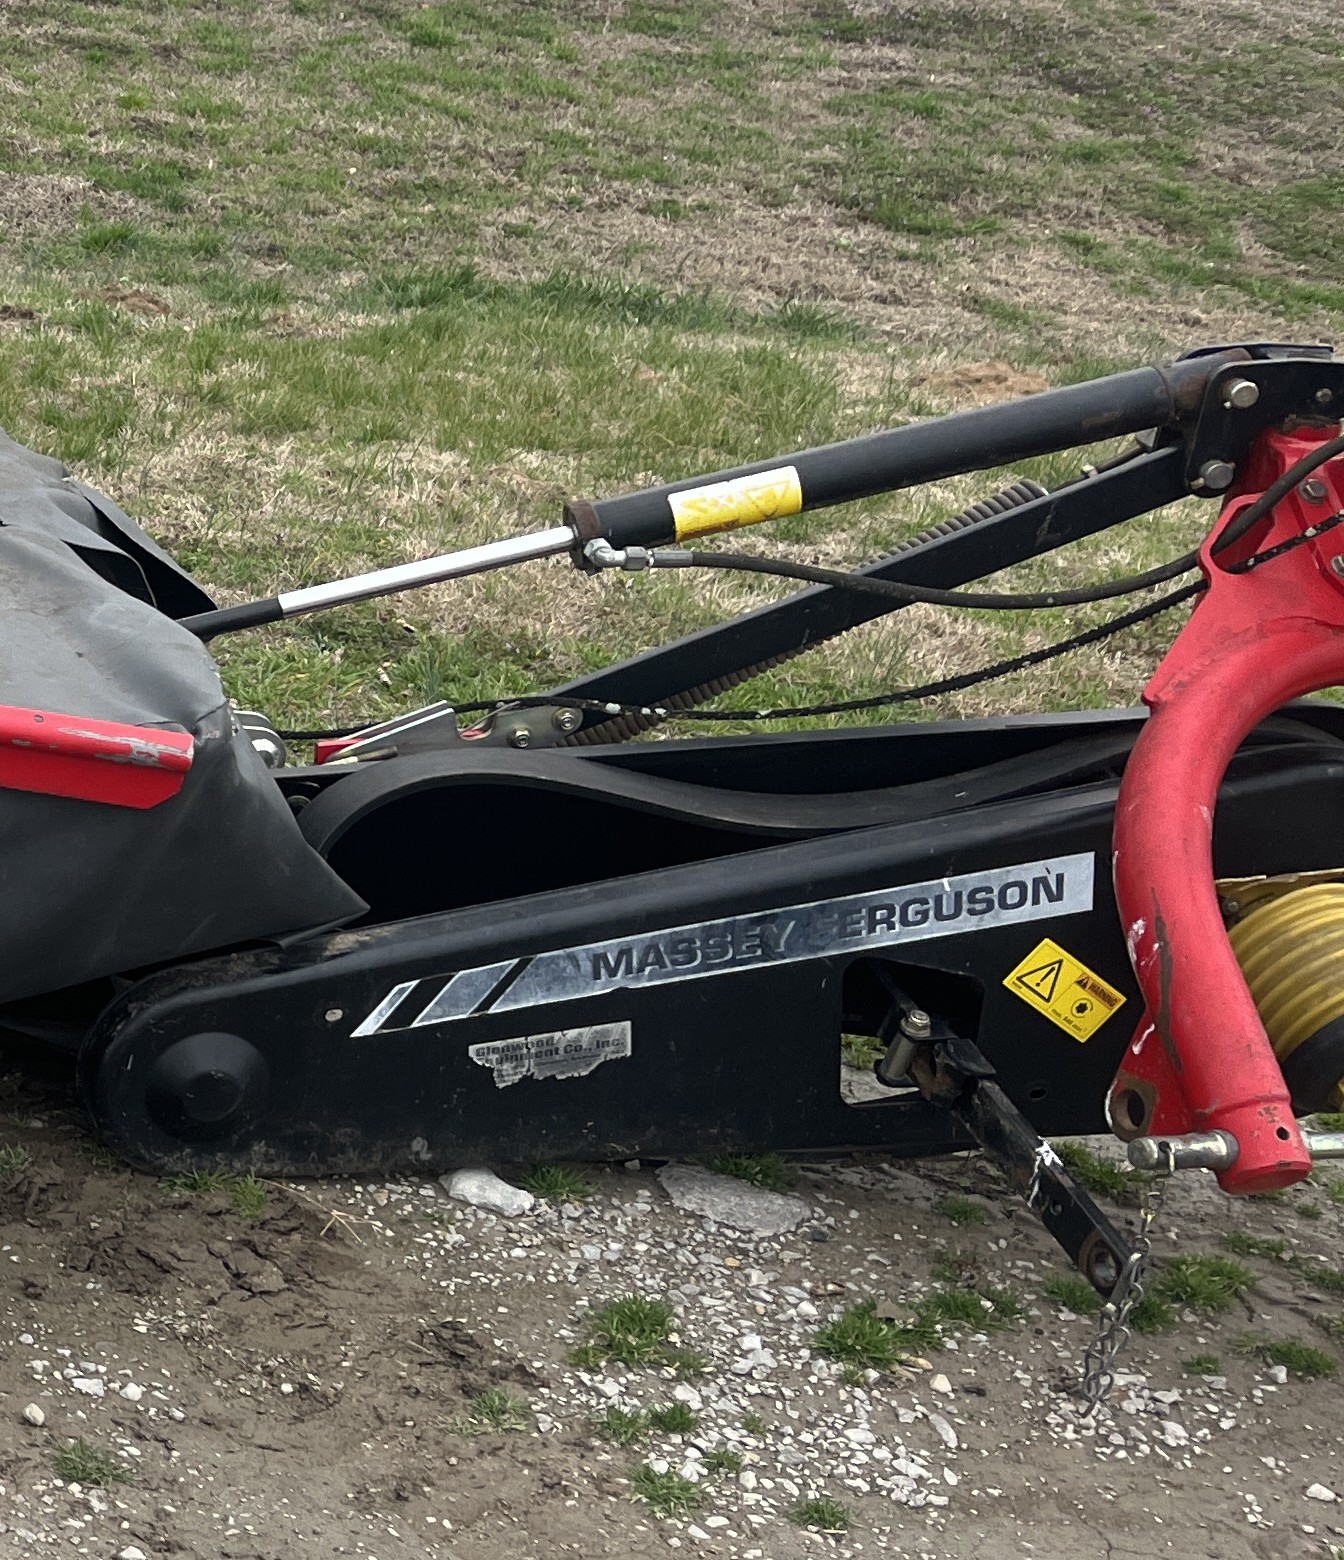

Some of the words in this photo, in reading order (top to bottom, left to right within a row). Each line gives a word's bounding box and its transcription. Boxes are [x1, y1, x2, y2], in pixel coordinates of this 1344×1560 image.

[592, 919, 796, 982] MASSEY
[818, 873, 1064, 941] ERGUSON
[595, 1037, 625, 1050] Inc.
